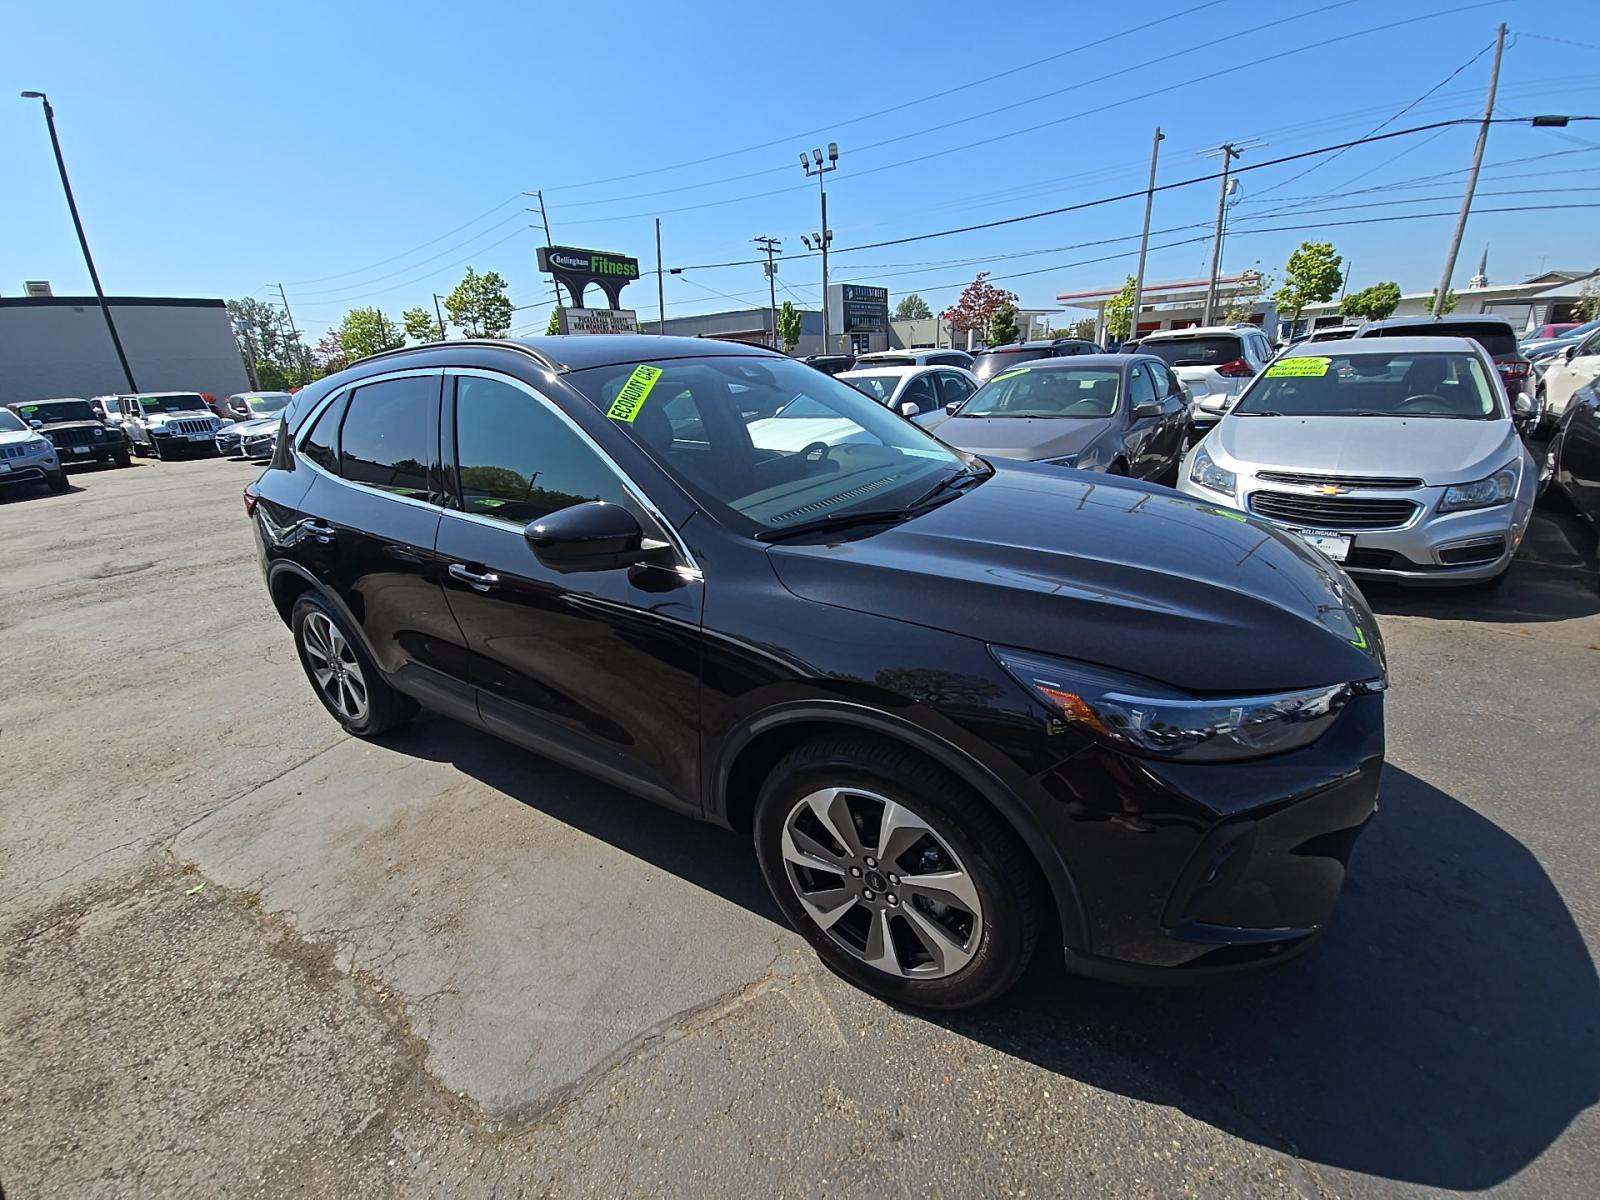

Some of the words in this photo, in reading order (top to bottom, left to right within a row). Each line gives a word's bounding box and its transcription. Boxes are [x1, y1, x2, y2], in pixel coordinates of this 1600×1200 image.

[555, 255, 589, 267] Bellingham
[590, 255, 637, 276] Fitness
[611, 378, 647, 420] ECONOMY
[635, 366, 657, 381] CAR
[1302, 529, 1338, 537] BELLINGHAM
